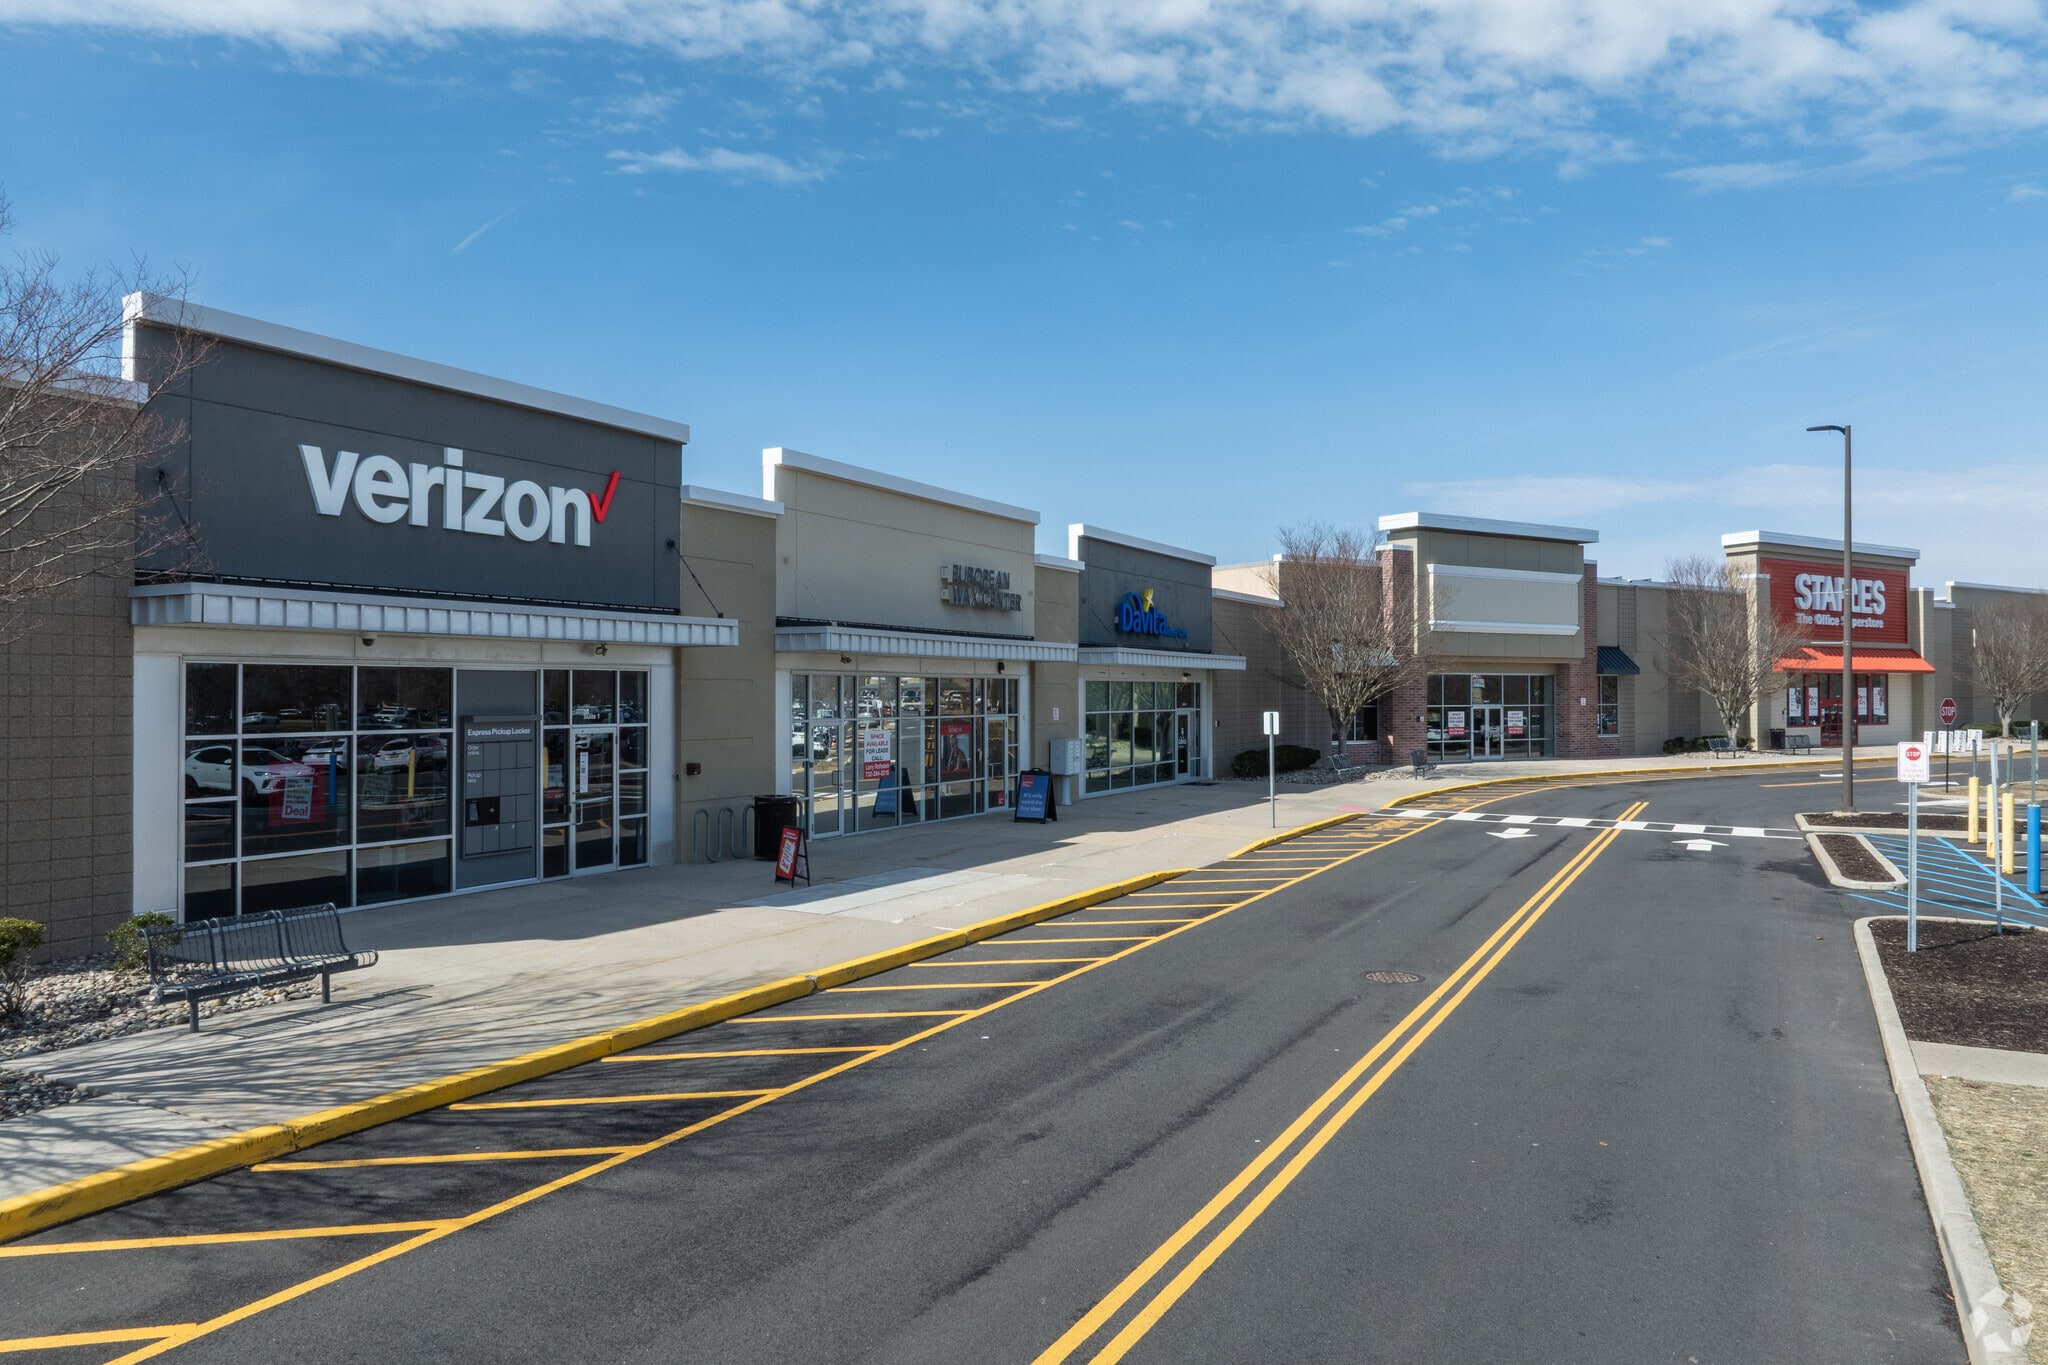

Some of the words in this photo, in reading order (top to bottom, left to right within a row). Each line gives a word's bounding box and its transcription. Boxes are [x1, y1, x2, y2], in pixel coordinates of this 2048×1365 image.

[298, 444, 591, 547] verizon
[952, 564, 1010, 590] EUROPEAN
[952, 586, 977, 607] WAX
[979, 590, 1022, 612] CENTER
[1119, 592, 1167, 635] DaVita
[1795, 612, 1813, 625] The
[1814, 613, 1840, 626] Office
[1840, 616, 1884, 629] perstore
[1941, 706, 1957, 717] STOP
[467, 728, 491, 737] Express
[491, 727, 512, 736] Pickup
[511, 727, 531, 735] Locker
[285, 805, 309, 816] Deal
